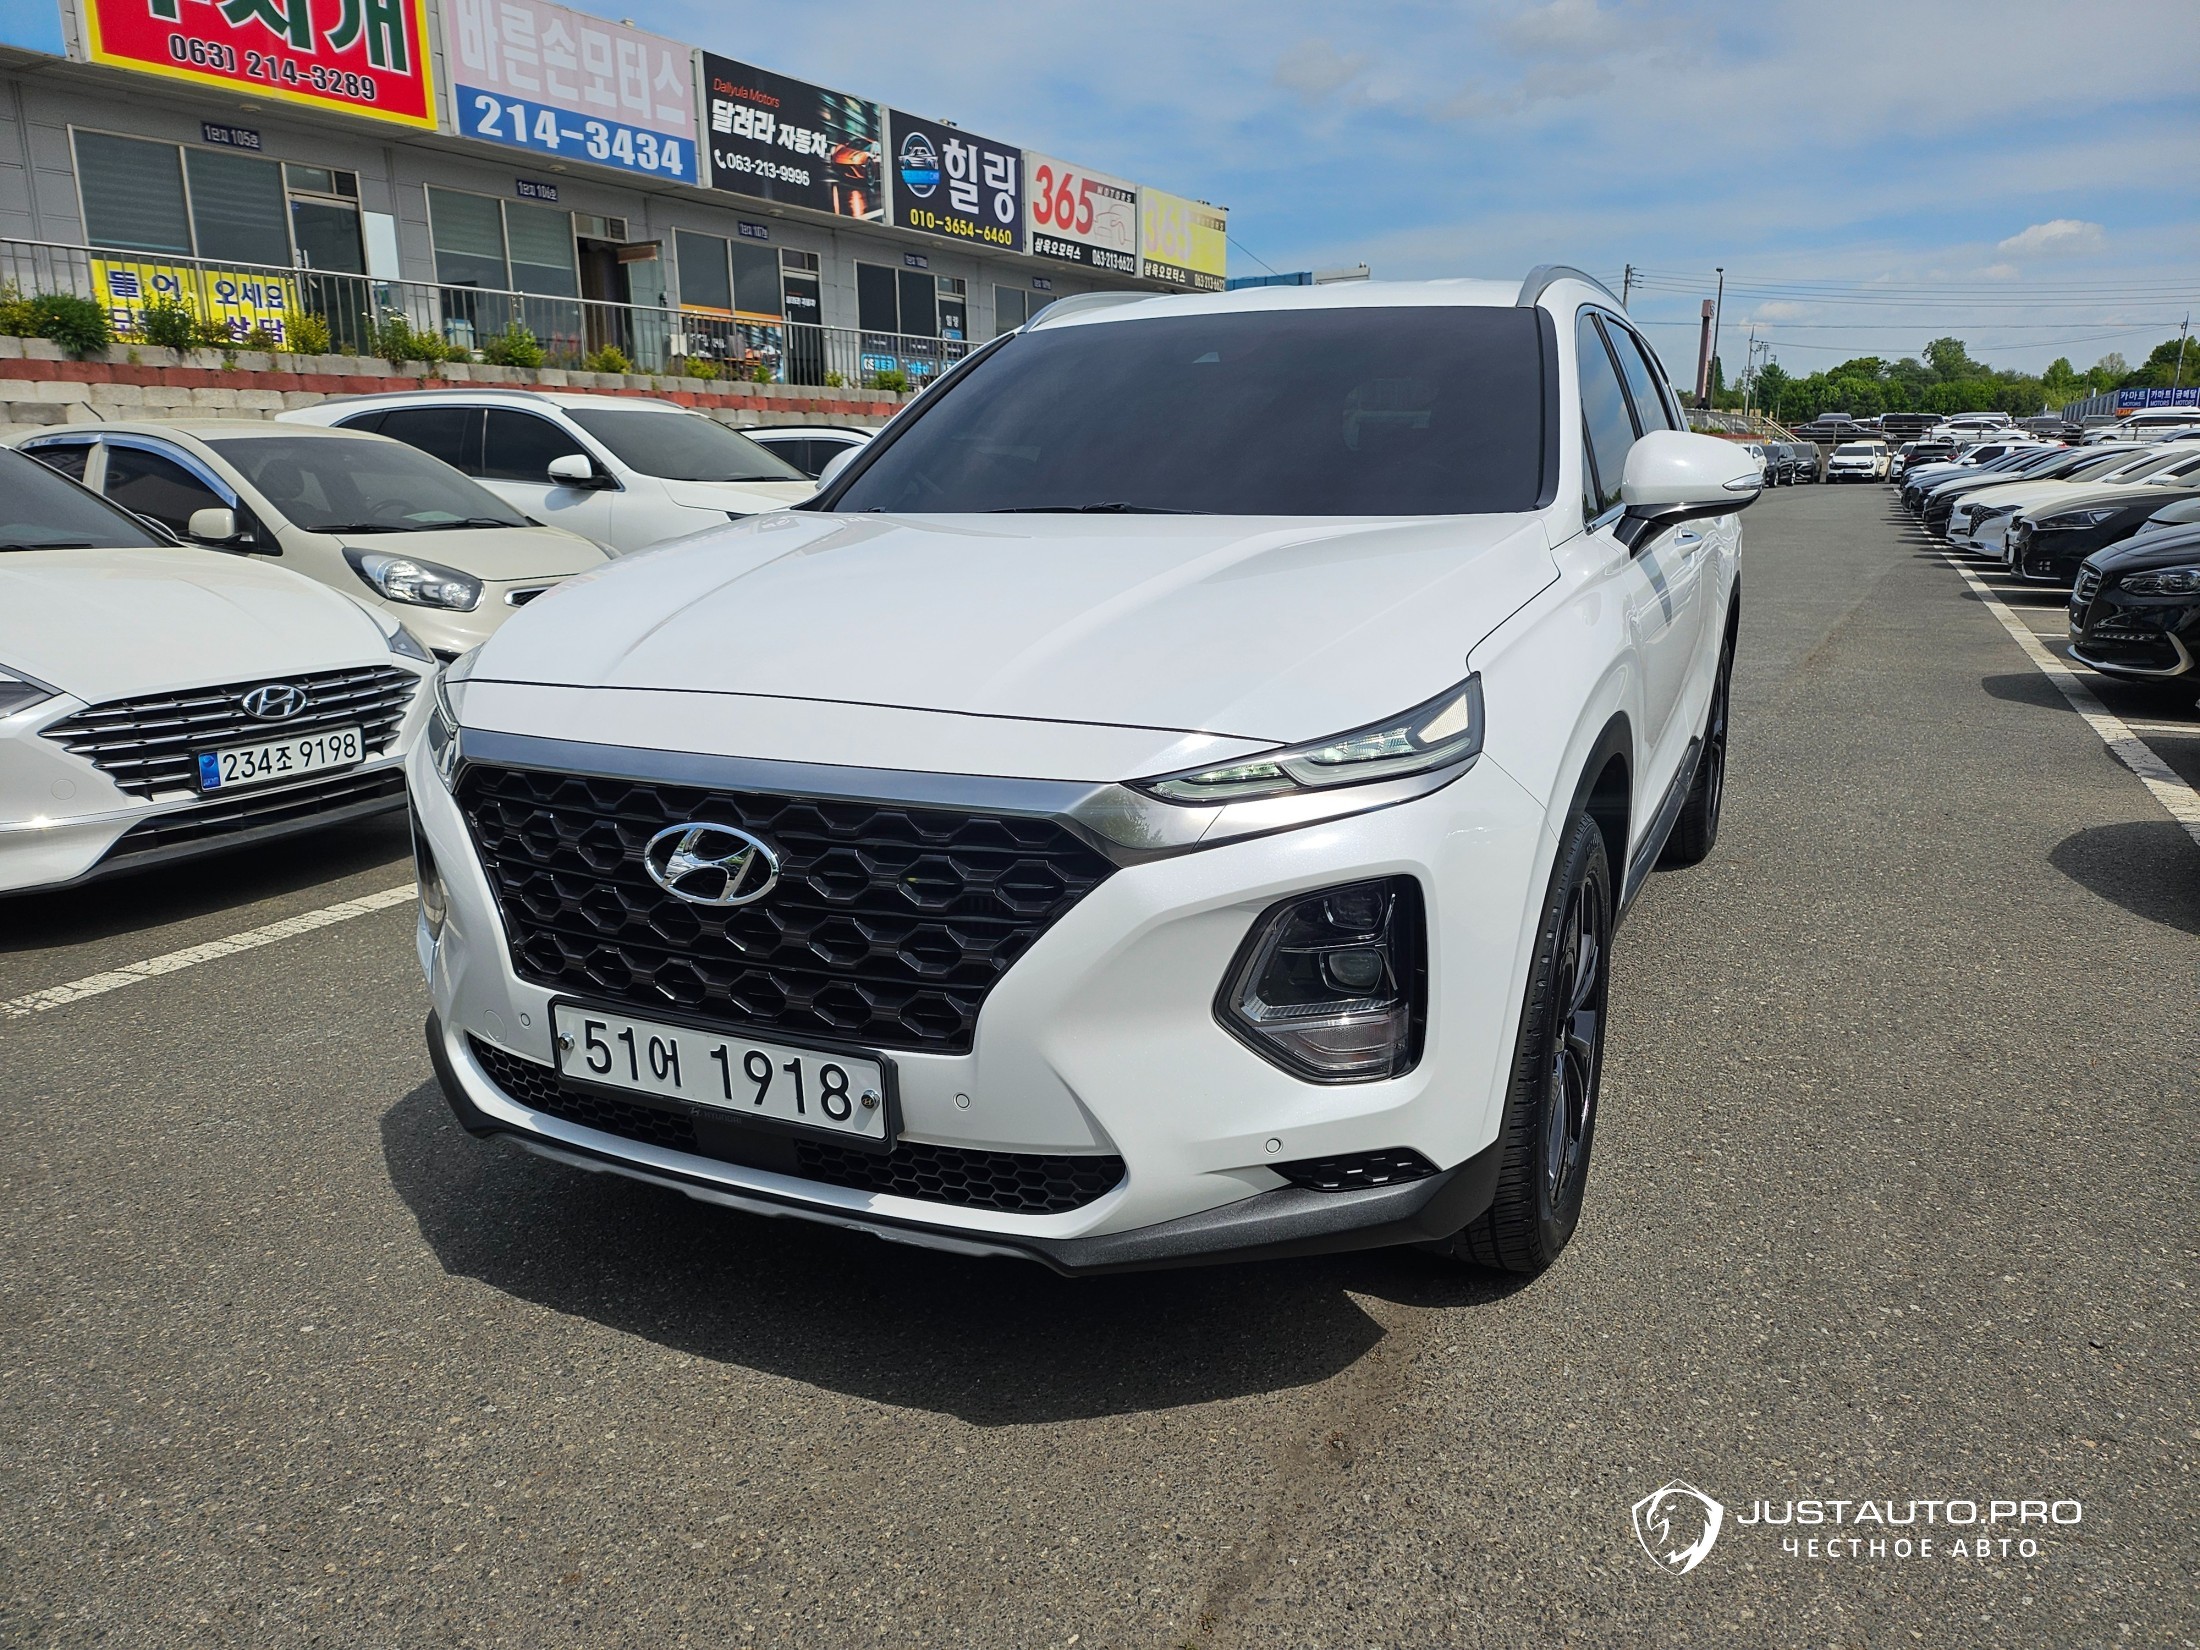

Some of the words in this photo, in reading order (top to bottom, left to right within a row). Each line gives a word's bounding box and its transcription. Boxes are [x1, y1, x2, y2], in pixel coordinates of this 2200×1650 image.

[168, 34, 235, 72] 063)
[245, 51, 377, 101] 214-3289
[457, 0, 687, 125] 바른손모터스
[713, 77, 748, 100] Dallyula
[749, 88, 781, 108] Motors
[231, 129, 260, 148] 105호
[474, 95, 684, 176] 214-3434
[712, 98, 776, 145] 달려라
[777, 123, 828, 159] 자동차
[725, 152, 811, 187] 063-213-9996
[942, 137, 1016, 224] 힐링
[1096, 184, 1132, 203] MOTORS
[1032, 164, 1094, 235] 365
[909, 208, 1013, 246] 010-3654-6460
[1144, 196, 1192, 264] 365
[1034, 237, 1081, 260] 삼육오모터스
[1092, 249, 1134, 273] 063-213-6622
[1144, 261, 1186, 283] 삼육오모터스
[214, 280, 285, 309] 오세요
[222, 746, 293, 782] 234조
[299, 733, 357, 768] 9198
[584, 1018, 683, 1089] 51어
[710, 1043, 853, 1122] 1918
